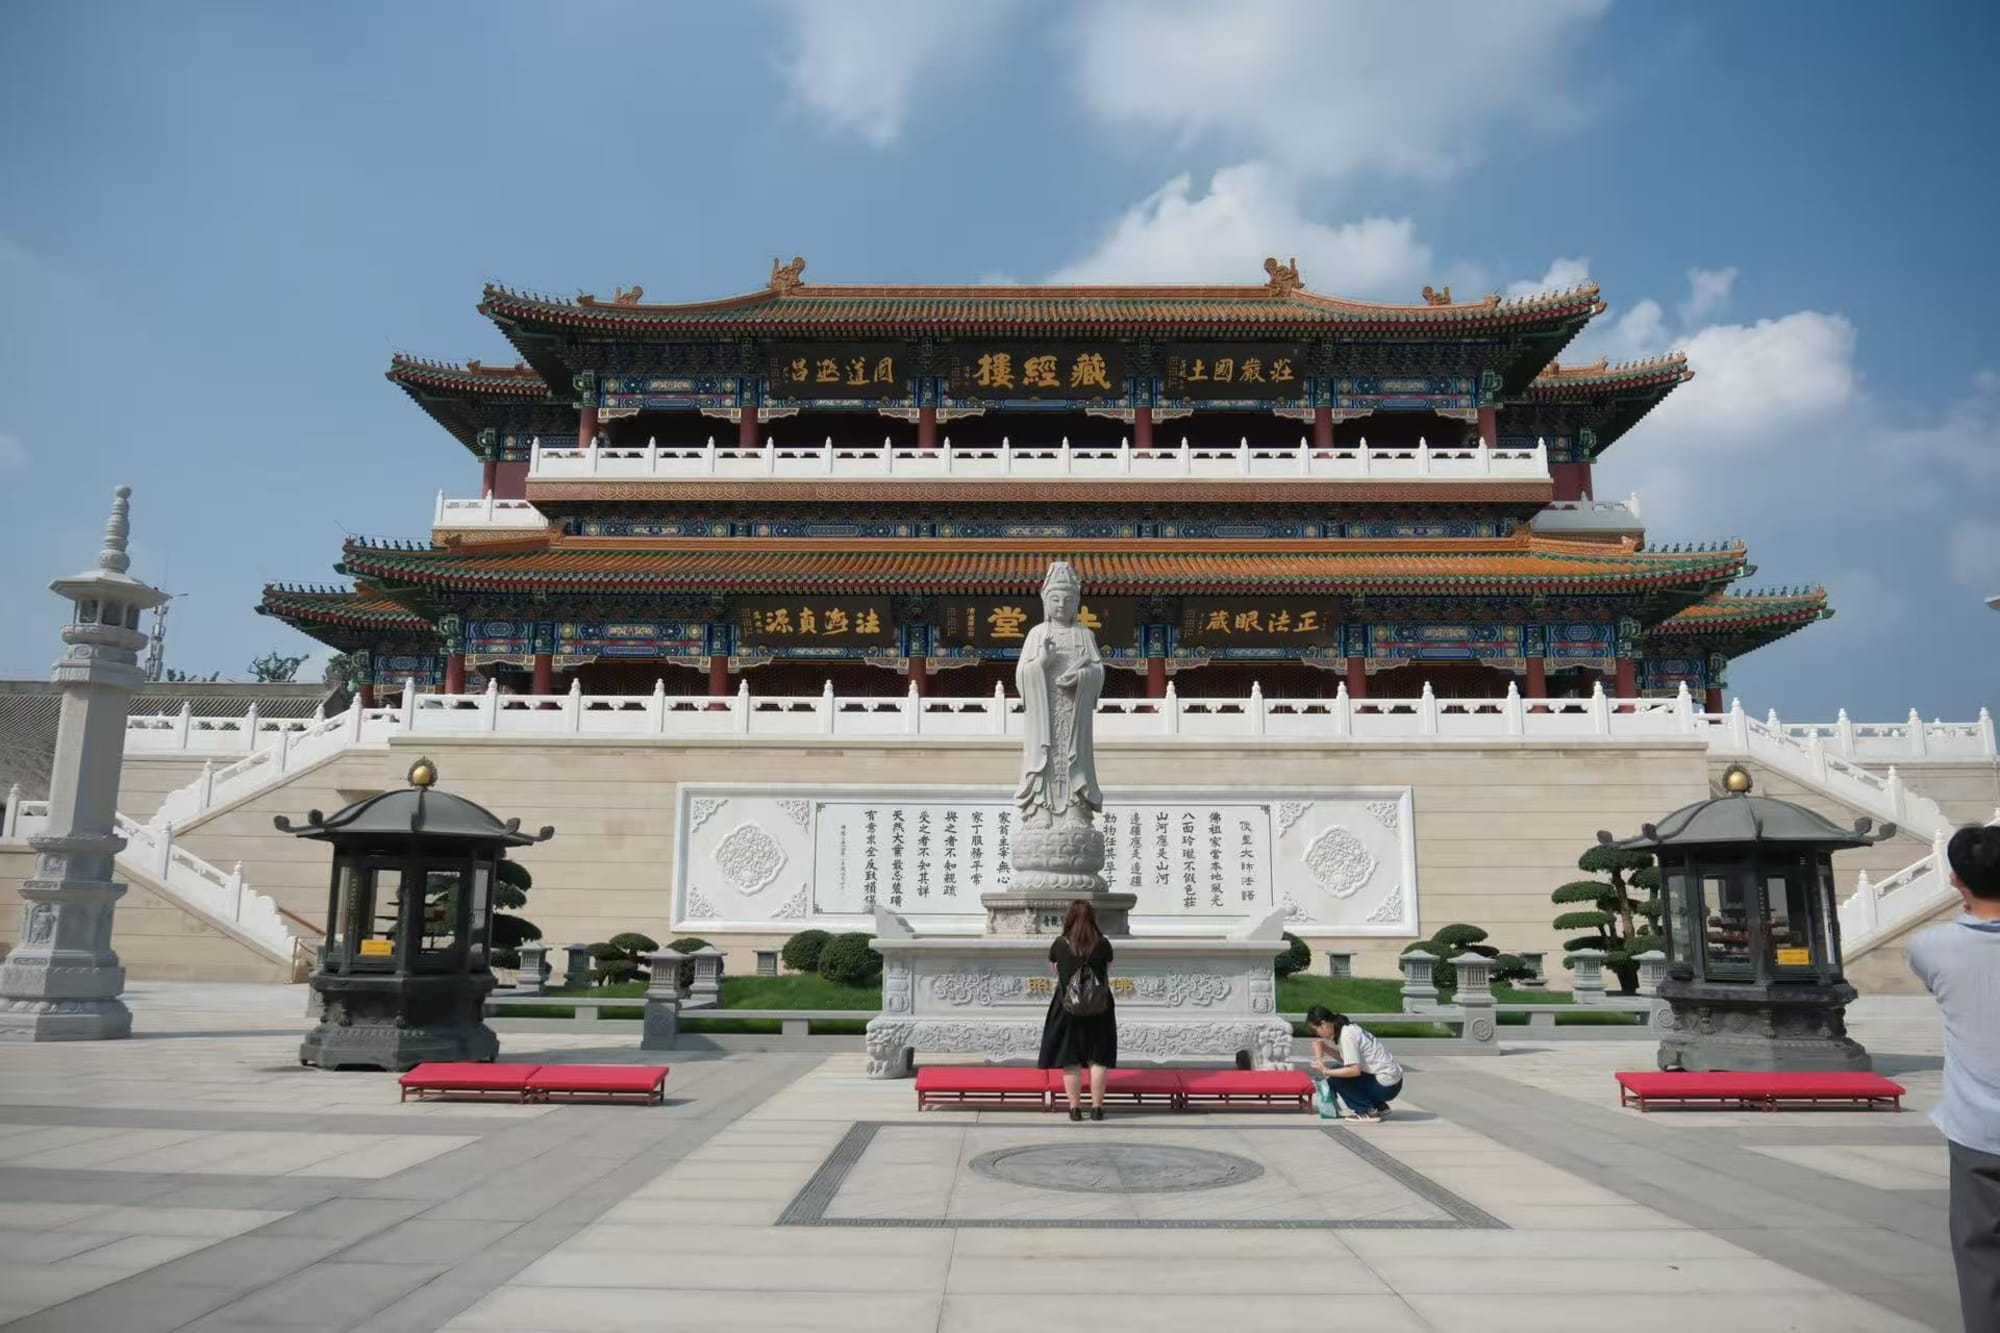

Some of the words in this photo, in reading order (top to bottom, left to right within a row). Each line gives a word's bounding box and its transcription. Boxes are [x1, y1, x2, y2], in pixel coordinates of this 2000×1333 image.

[973, 352, 1112, 389] 藏經樓
[1187, 357, 1295, 383] 莊嚴國土
[1205, 609, 1320, 634] 正法眼藏
[916, 810, 932, 899] 受之者不知其詳
[943, 810, 959, 898] 與之者不知親疏
[969, 811, 984, 886] 家丁服務平常
[996, 811, 1012, 885] 家翁主宰無心
[1155, 811, 1170, 886] 山河應是山河
